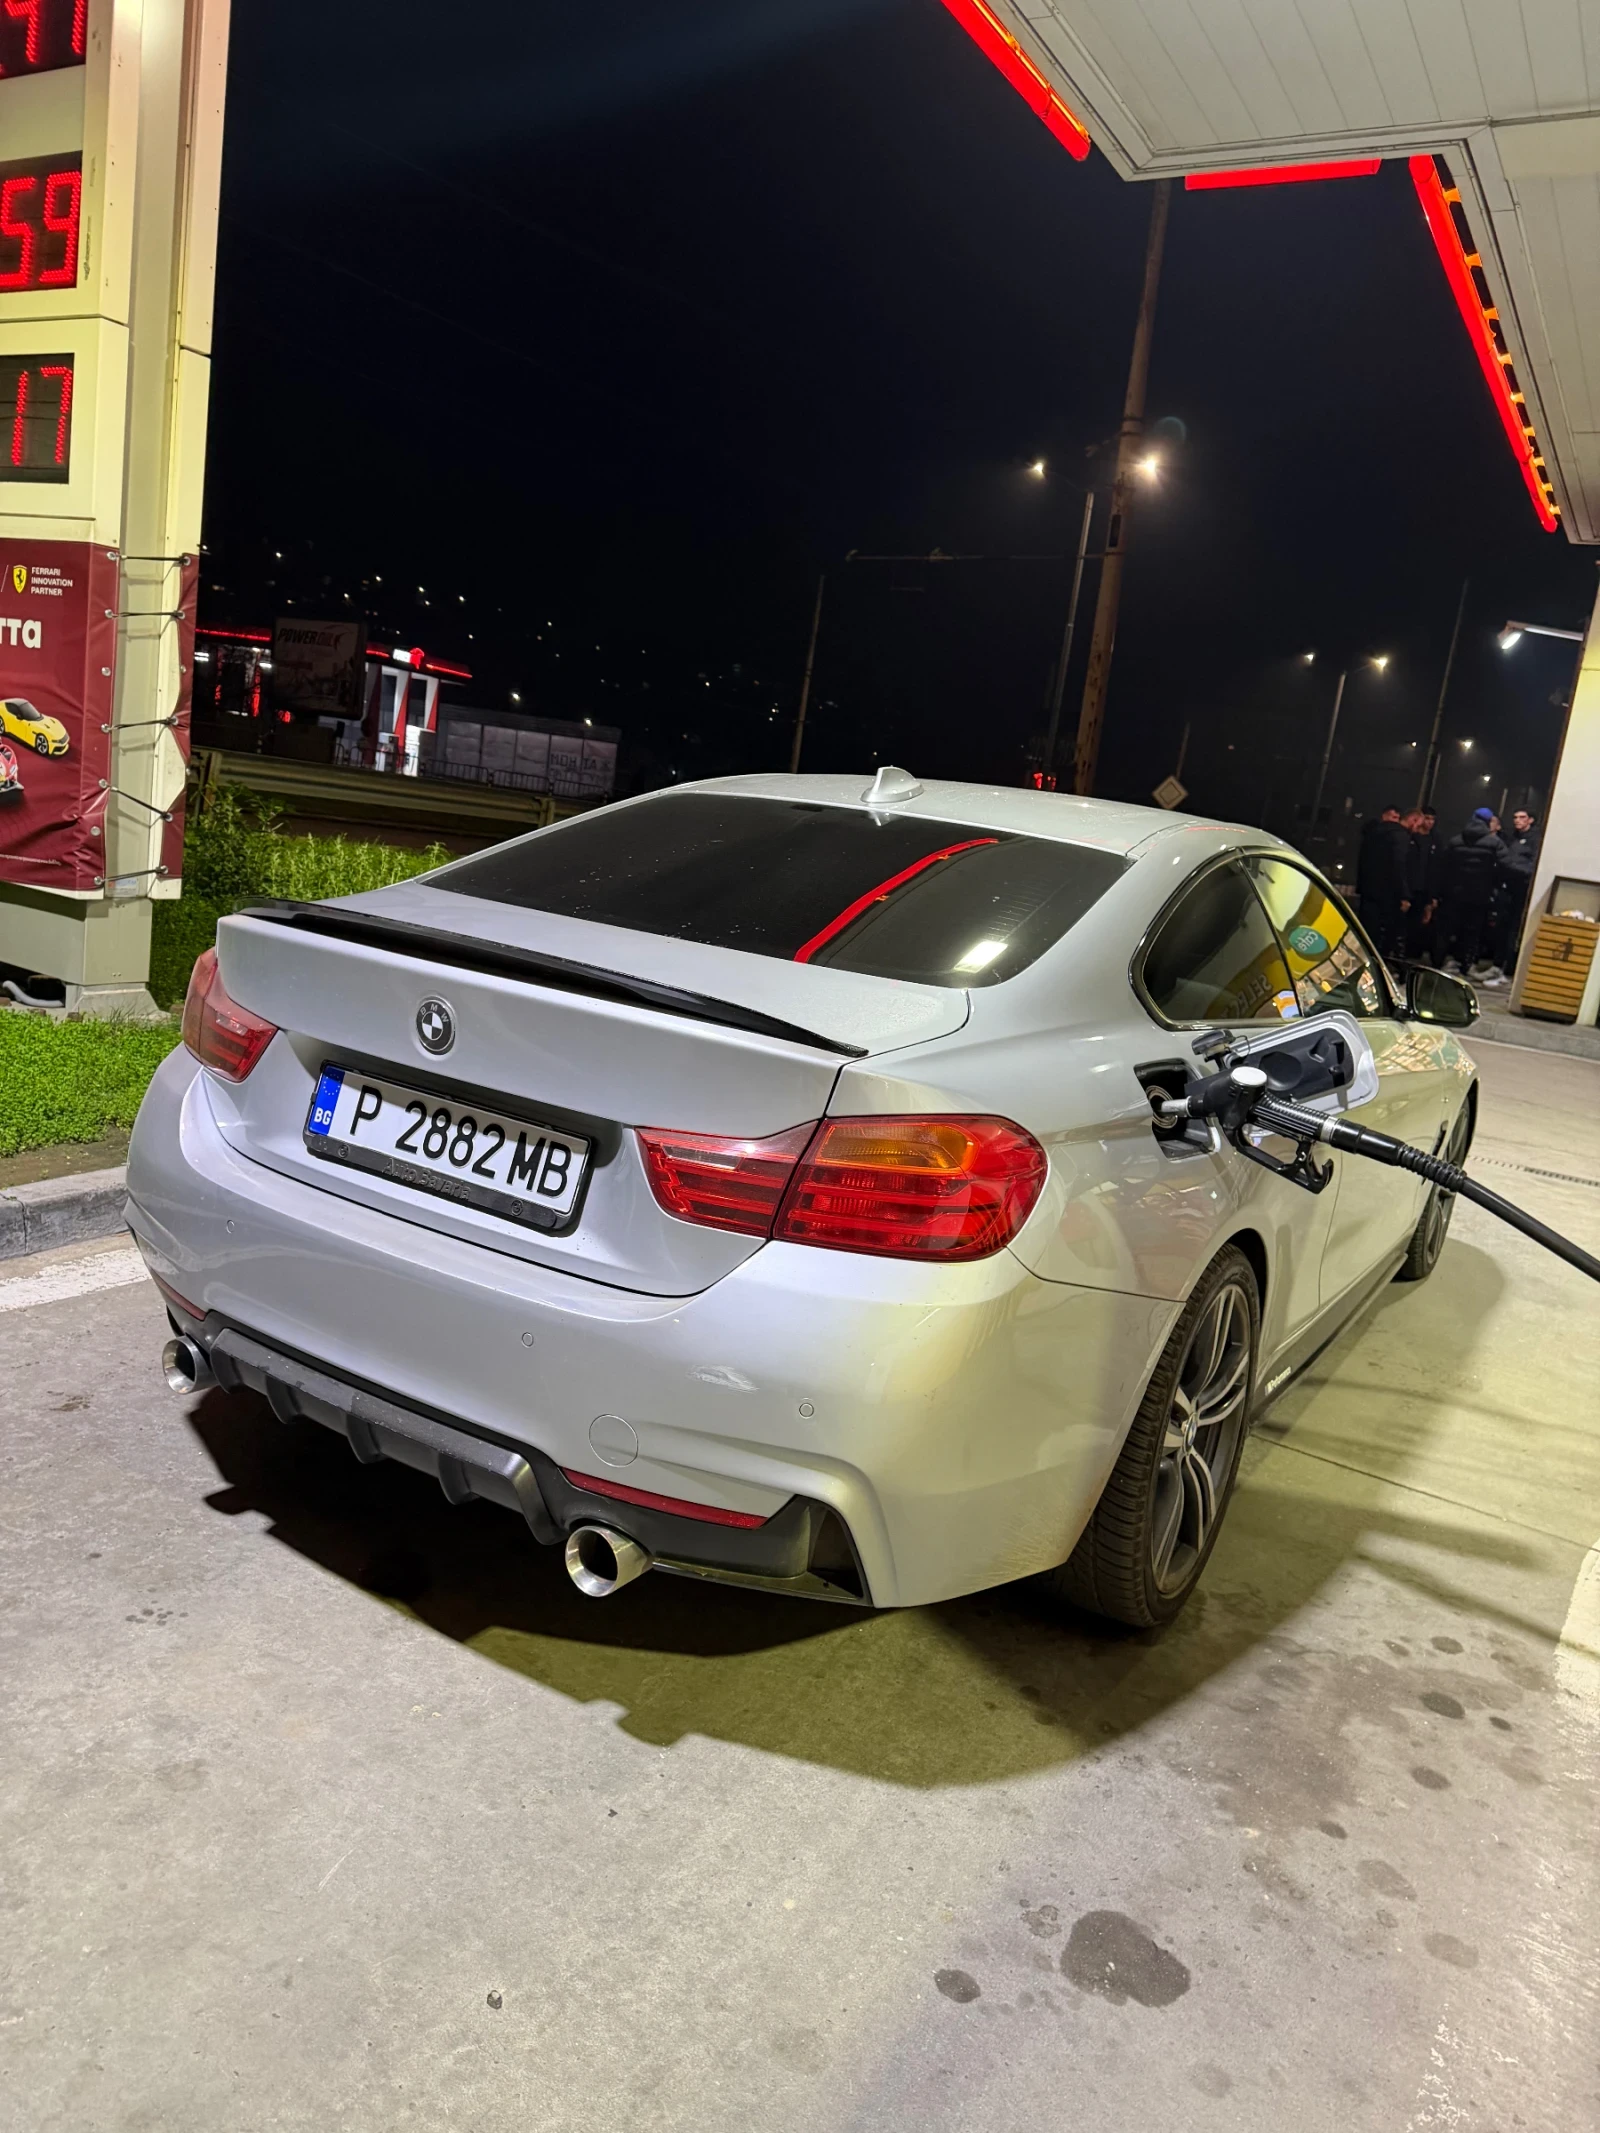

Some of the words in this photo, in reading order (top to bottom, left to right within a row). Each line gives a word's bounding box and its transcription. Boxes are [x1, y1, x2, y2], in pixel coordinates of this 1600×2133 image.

[11, 366, 72, 466] 17
[31, 567, 61, 576] FERRARI
[30, 586, 63, 597] PARTNER
[31, 577, 73, 588] INNOVATION
[420, 1003, 450, 1023] BMW
[313, 1107, 332, 1126] BG
[395, 1100, 506, 1179] 2882
[506, 1131, 572, 1198] MB
